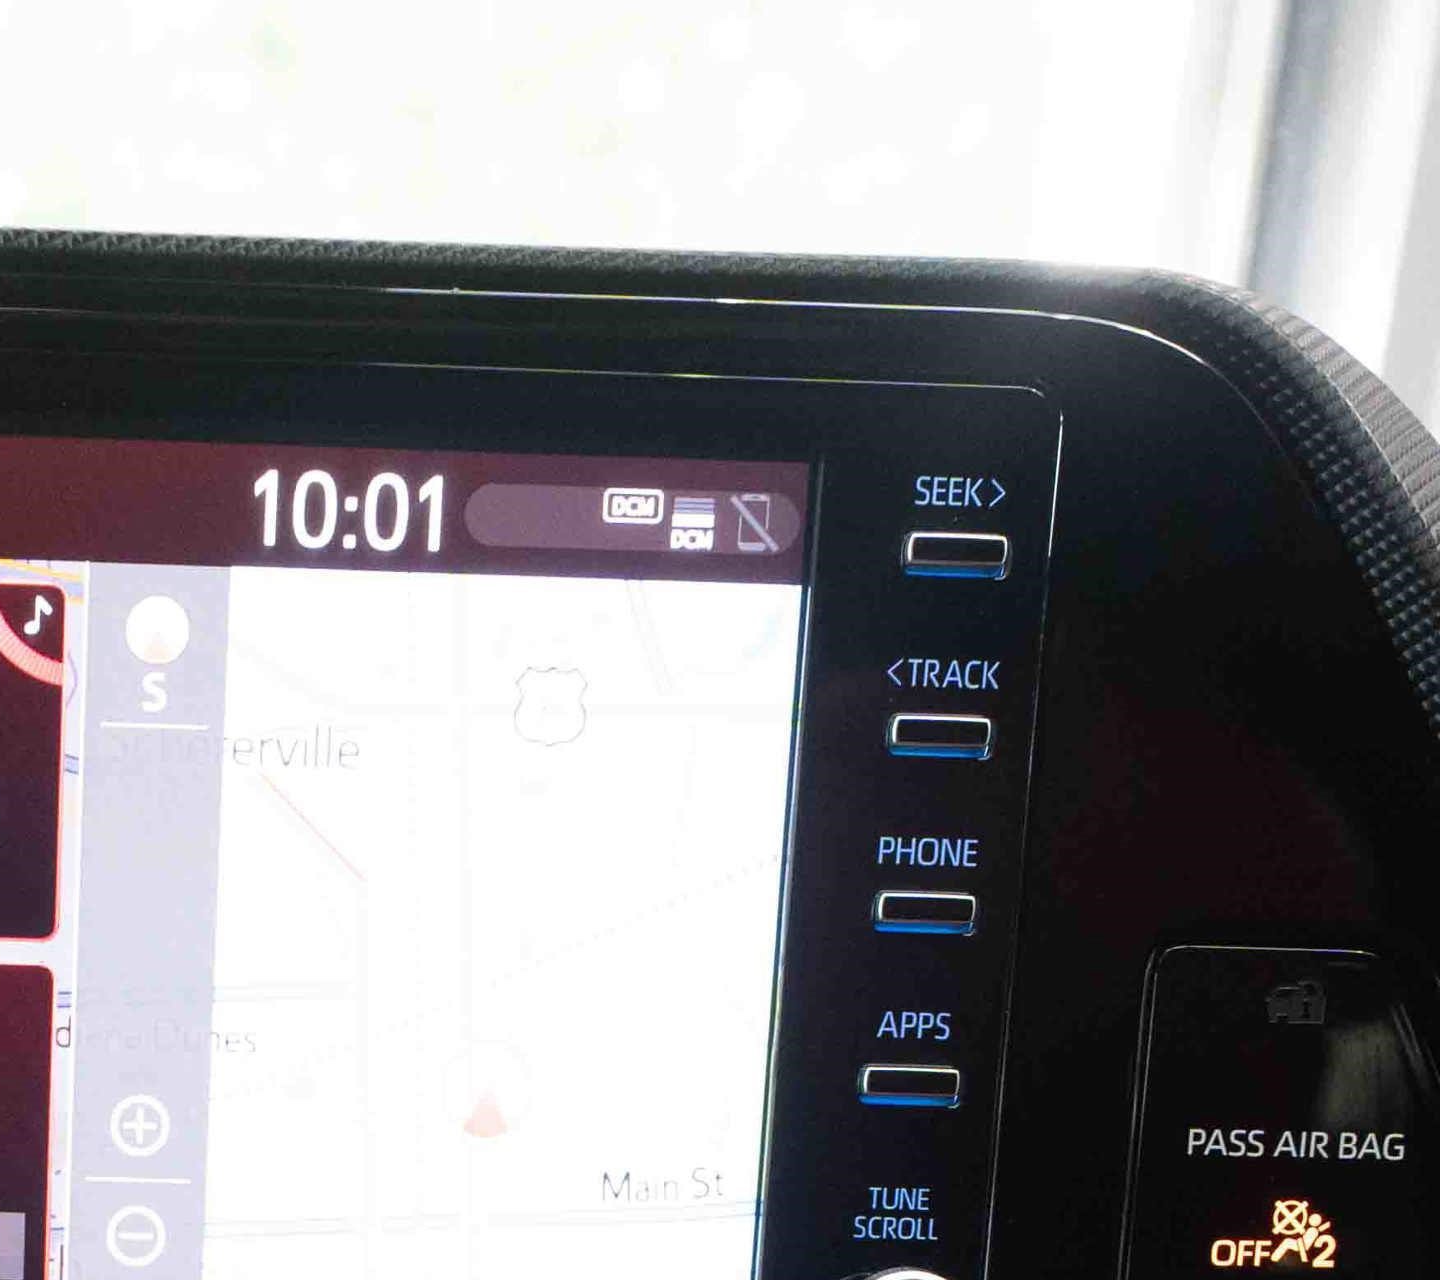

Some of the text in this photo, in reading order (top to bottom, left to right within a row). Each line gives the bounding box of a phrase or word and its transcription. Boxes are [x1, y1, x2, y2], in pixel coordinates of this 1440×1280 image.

[253, 468, 444, 553] 10:01
[610, 494, 657, 523] DCM
[670, 528, 715, 551] DCM
[138, 670, 170, 716] S
[877, 836, 979, 867] PHONE
[876, 1010, 951, 1041] APPS
[1187, 1128, 1405, 1161] PASS AIR BAG
[691, 1167, 724, 1200] St
[868, 1186, 930, 1211] TUNE
[853, 1215, 938, 1240] SCROLL
[1209, 1238, 1273, 1268] OFF
